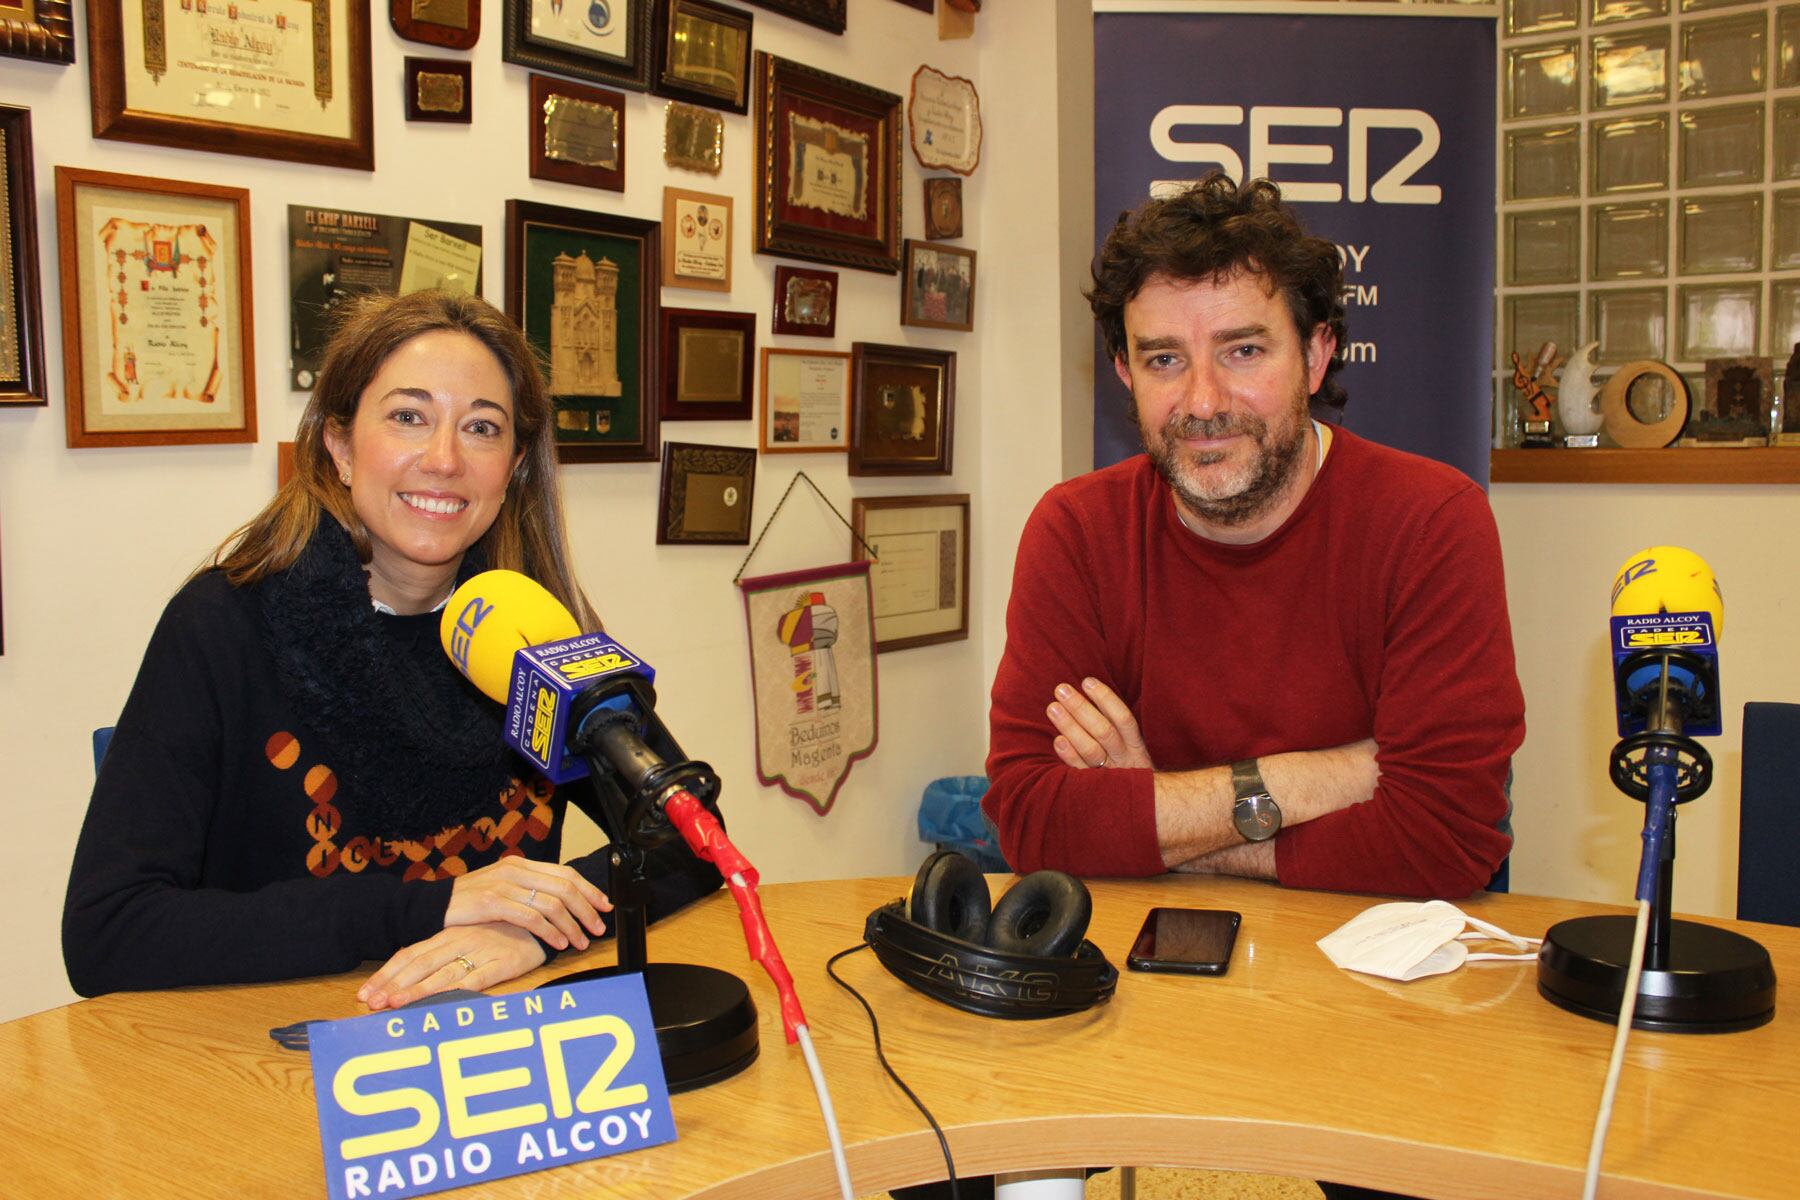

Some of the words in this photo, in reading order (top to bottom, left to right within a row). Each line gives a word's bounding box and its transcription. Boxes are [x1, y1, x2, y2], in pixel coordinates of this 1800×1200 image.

[1150, 105, 1442, 204] SER
[1627, 617, 1661, 626] RADIO
[1663, 615, 1700, 624] ALCOY
[1627, 626, 1703, 634] CADENA
[535, 644, 569, 658] RADIO
[569, 636, 601, 650] ALCOY
[549, 647, 616, 667] CADENA
[1628, 631, 1704, 647] SER
[559, 653, 633, 680] SER
[515, 667, 527, 704] ALCOY
[510, 703, 523, 739] RADIO
[524, 678, 539, 748] CADENA
[531, 687, 556, 762] SER
[387, 990, 577, 1037] CADENA
[332, 1014, 648, 1161] SER
[345, 1142, 491, 1200] RADIO
[518, 1108, 653, 1165] ALCOY
